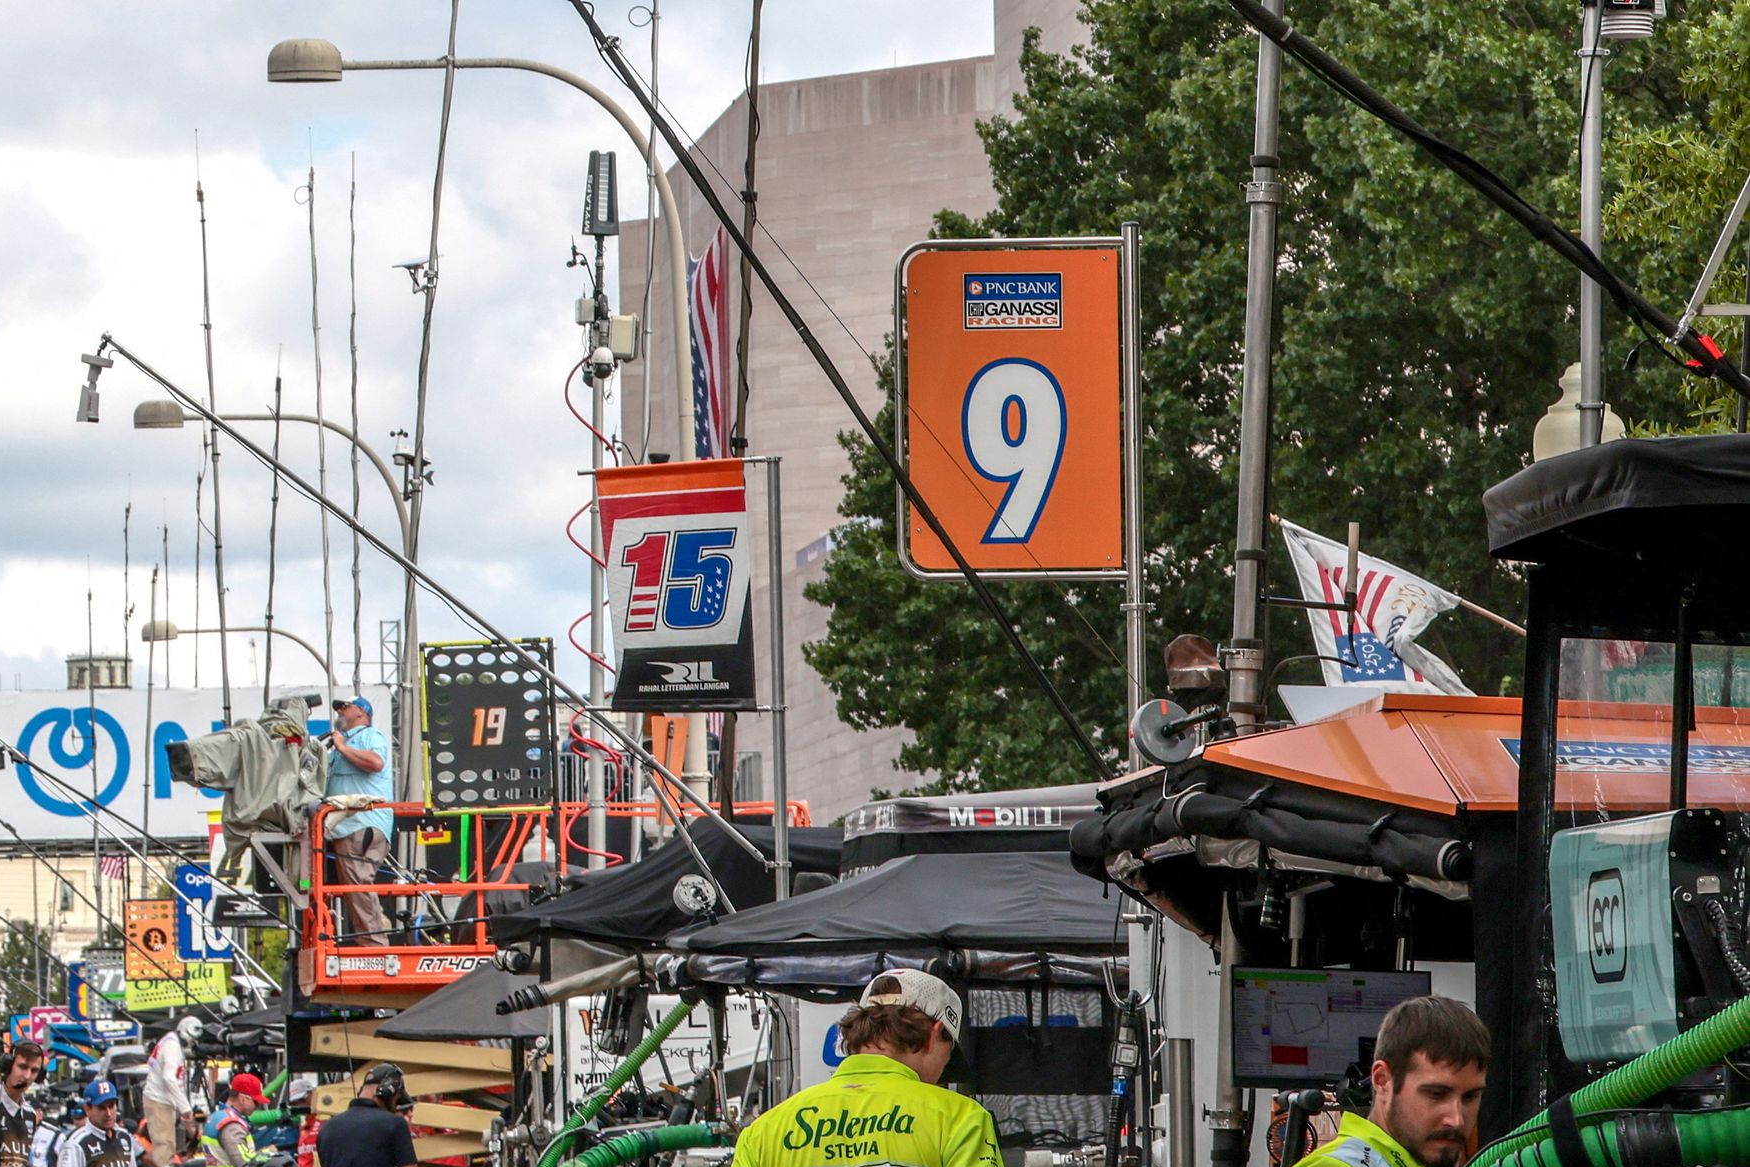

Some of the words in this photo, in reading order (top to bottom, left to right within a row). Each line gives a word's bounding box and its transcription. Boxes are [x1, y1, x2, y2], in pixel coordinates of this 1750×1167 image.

[584, 174, 594, 233] MYLAPS
[985, 282, 1016, 294] PNC
[1017, 281, 1057, 294] BANK
[968, 317, 1058, 326] RACING
[985, 302, 1058, 316] GANASSI
[962, 357, 1067, 544] 9
[621, 527, 738, 633] 15
[700, 682, 730, 691] LANIGAN
[472, 706, 507, 747] 19
[949, 806, 1029, 827] Mobil
[1593, 895, 1619, 957] ecr
[783, 1104, 915, 1151] Splenda
[825, 1141, 880, 1160] STEVIA
